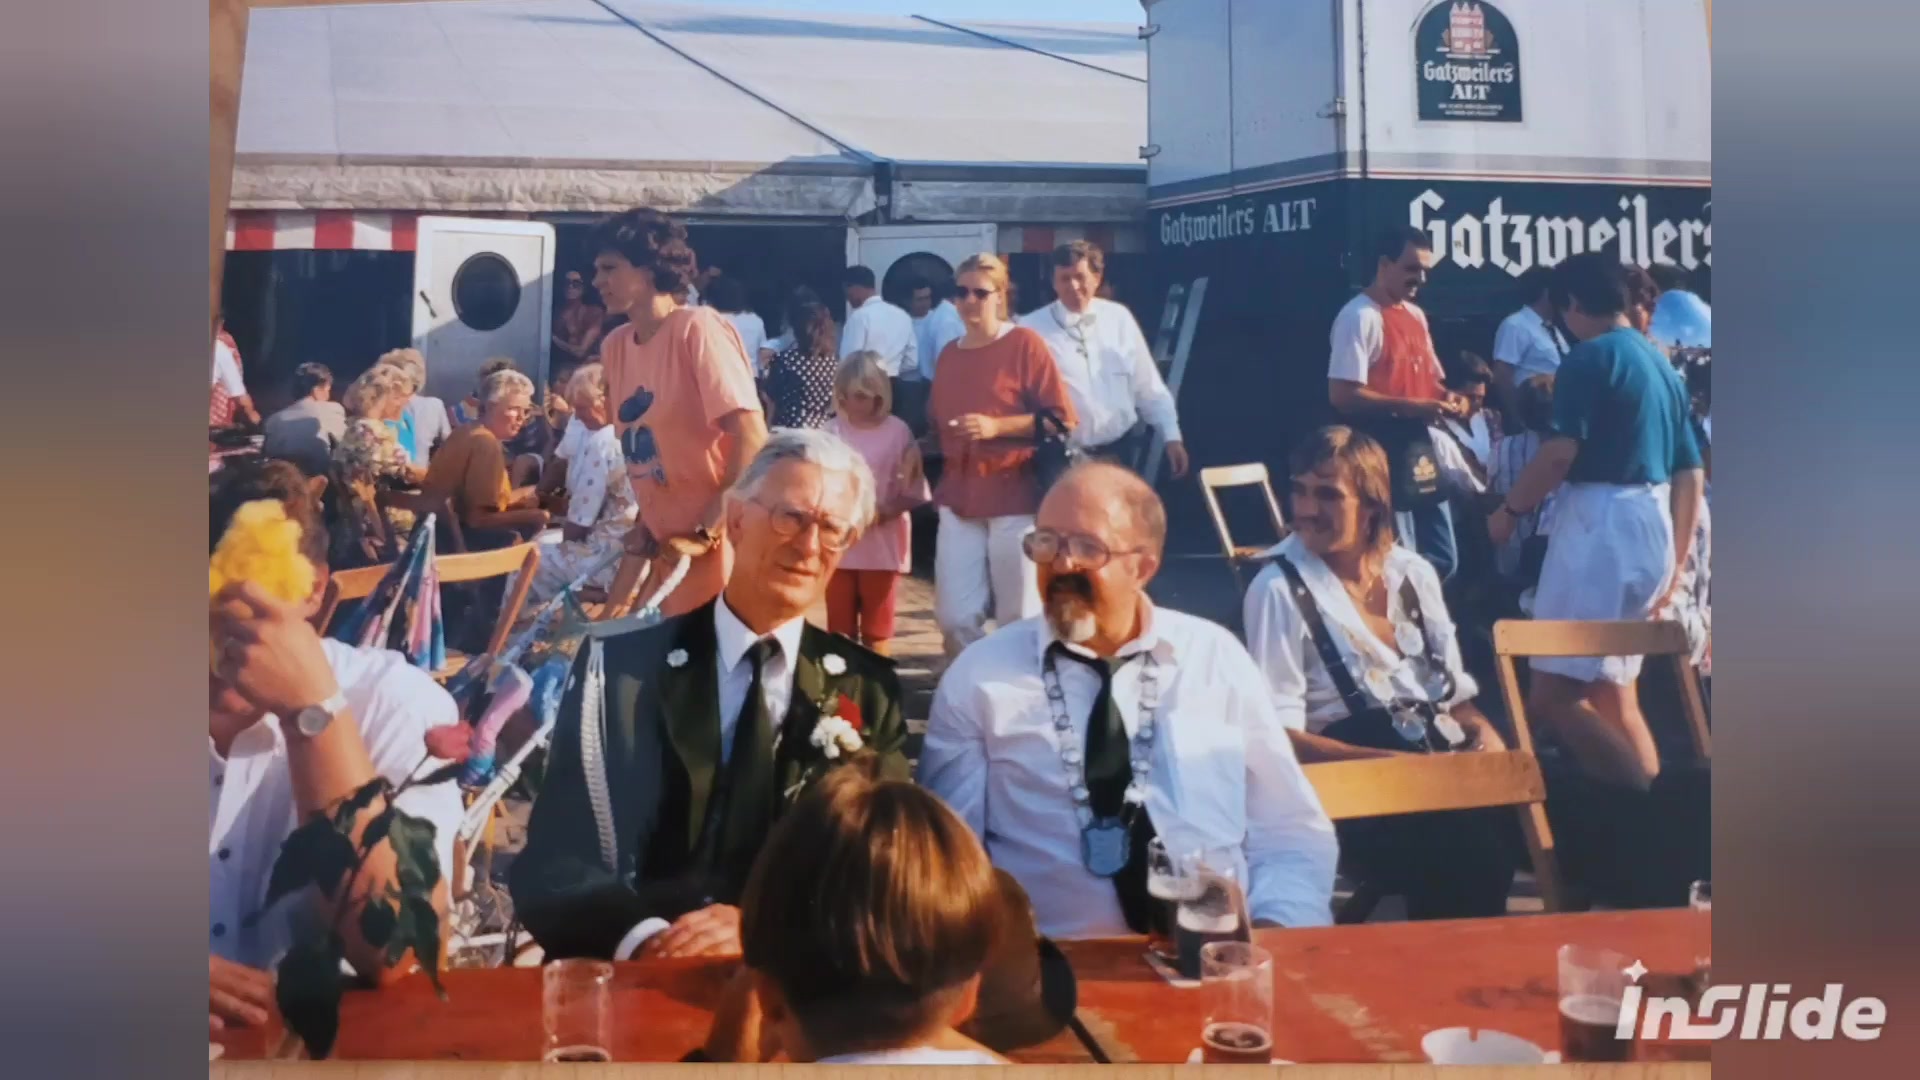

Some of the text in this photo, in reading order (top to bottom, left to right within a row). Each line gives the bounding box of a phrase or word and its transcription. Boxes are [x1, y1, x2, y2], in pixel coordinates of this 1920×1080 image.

[1423, 60, 1515, 84] Gatzweilers
[1450, 83, 1491, 101] ALT
[1160, 198, 1317, 247] Gatzweilers ALT
